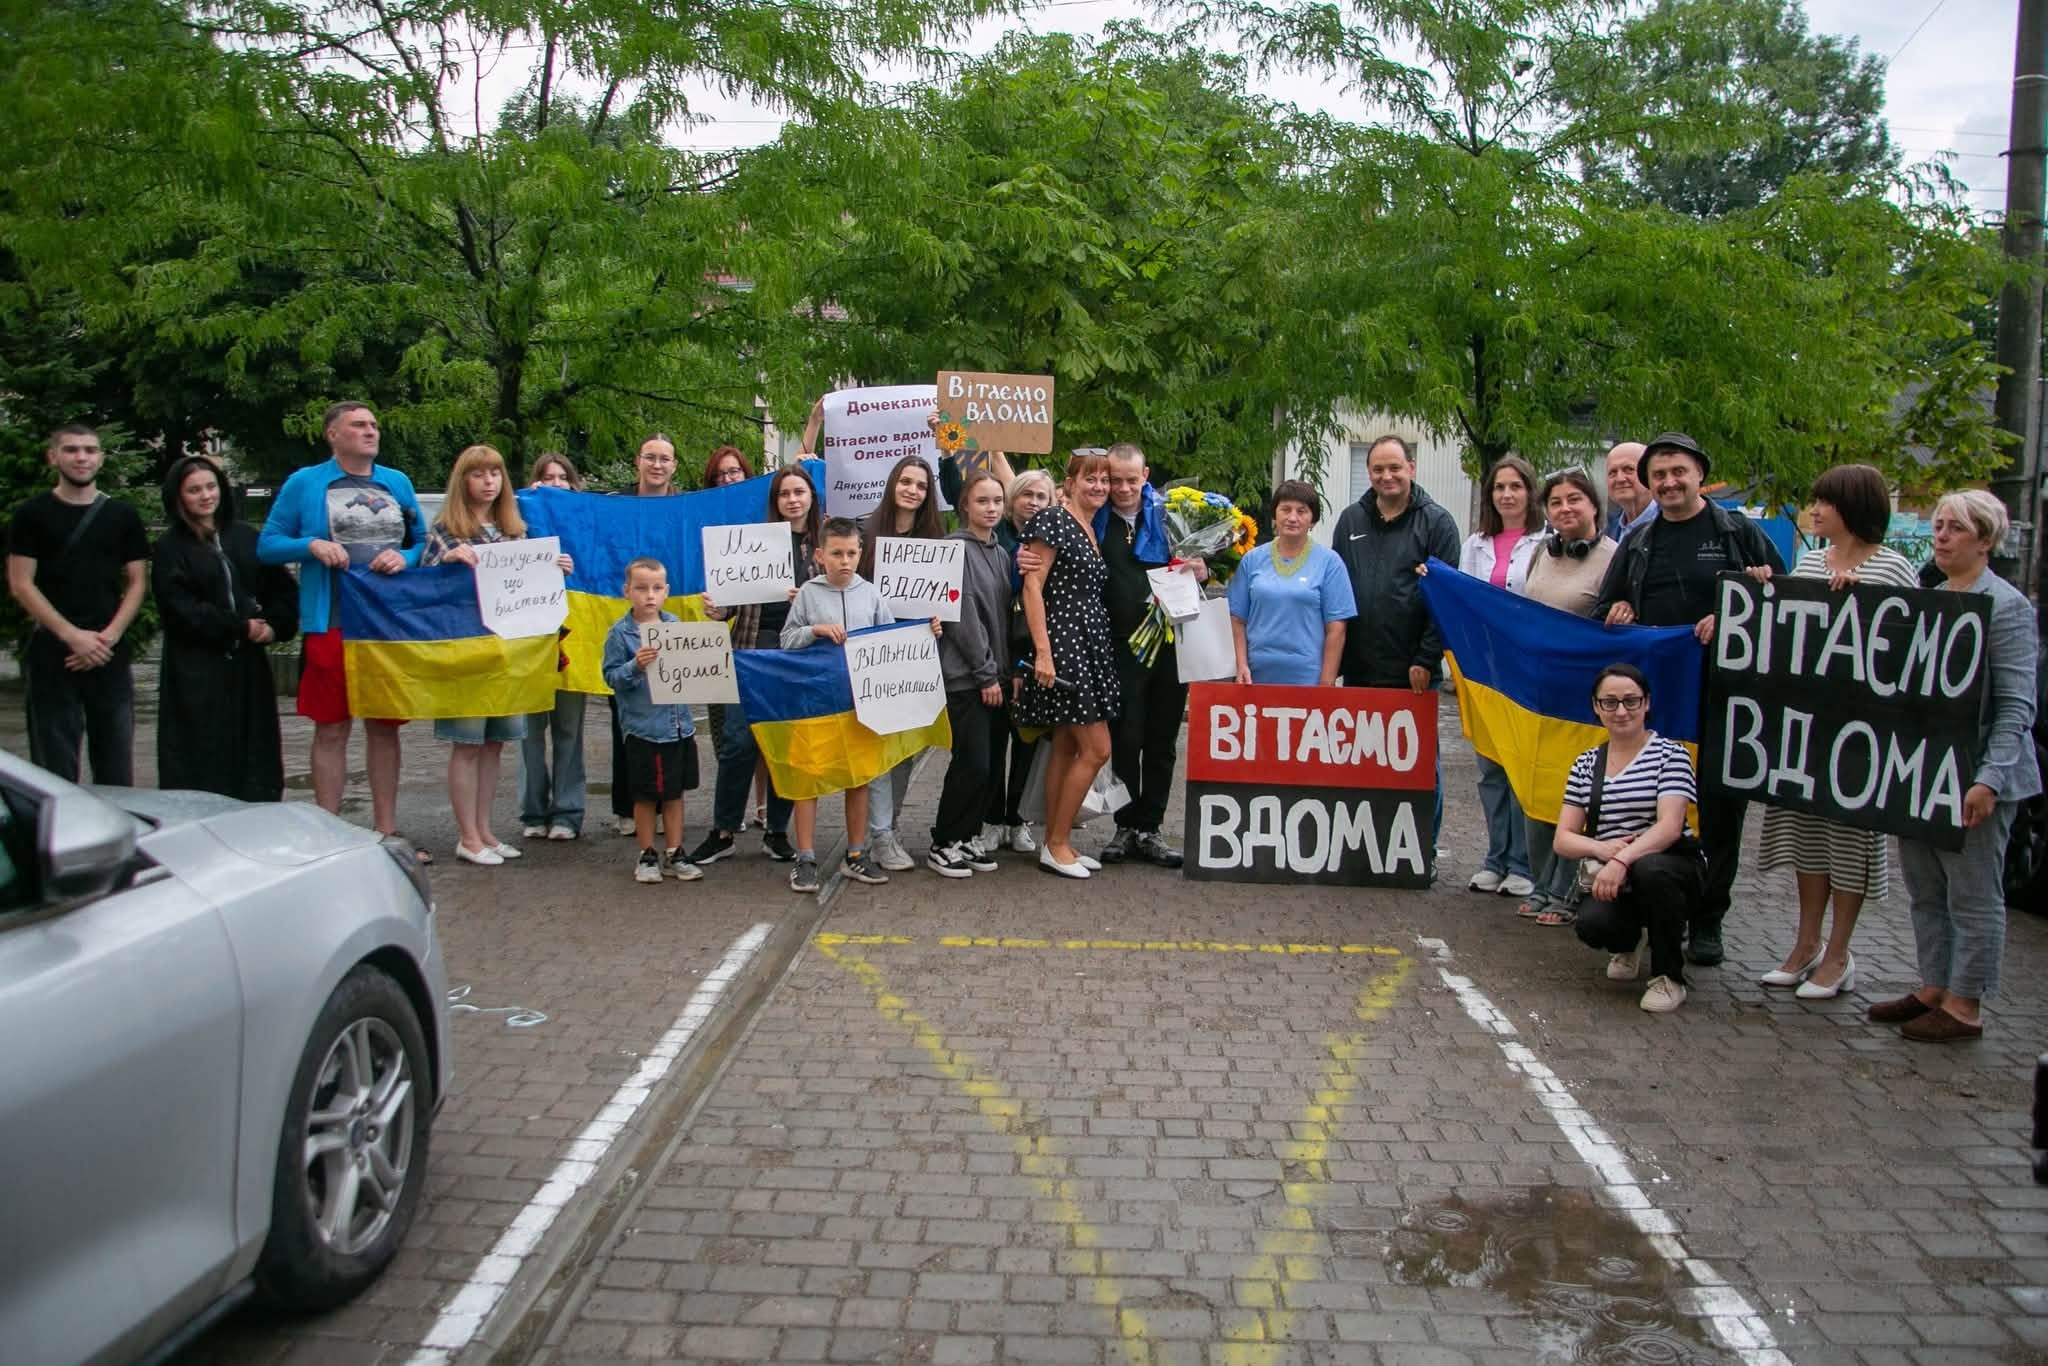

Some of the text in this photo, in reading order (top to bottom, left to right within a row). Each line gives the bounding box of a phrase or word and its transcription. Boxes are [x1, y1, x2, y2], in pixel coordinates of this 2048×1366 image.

[825, 434, 888, 448] Вітаємо
[854, 444, 921, 460] Олексій!
[834, 480, 885, 492] Дякуємо
[719, 527, 768, 557] Ми
[710, 551, 792, 586] чекали!
[880, 575, 949, 602] ВДОМА
[658, 652, 729, 694] вдома!
[859, 673, 940, 704] Дочекались!
[1722, 696, 1963, 828] ВДОМА
[1198, 794, 1425, 875] ВДОМА
